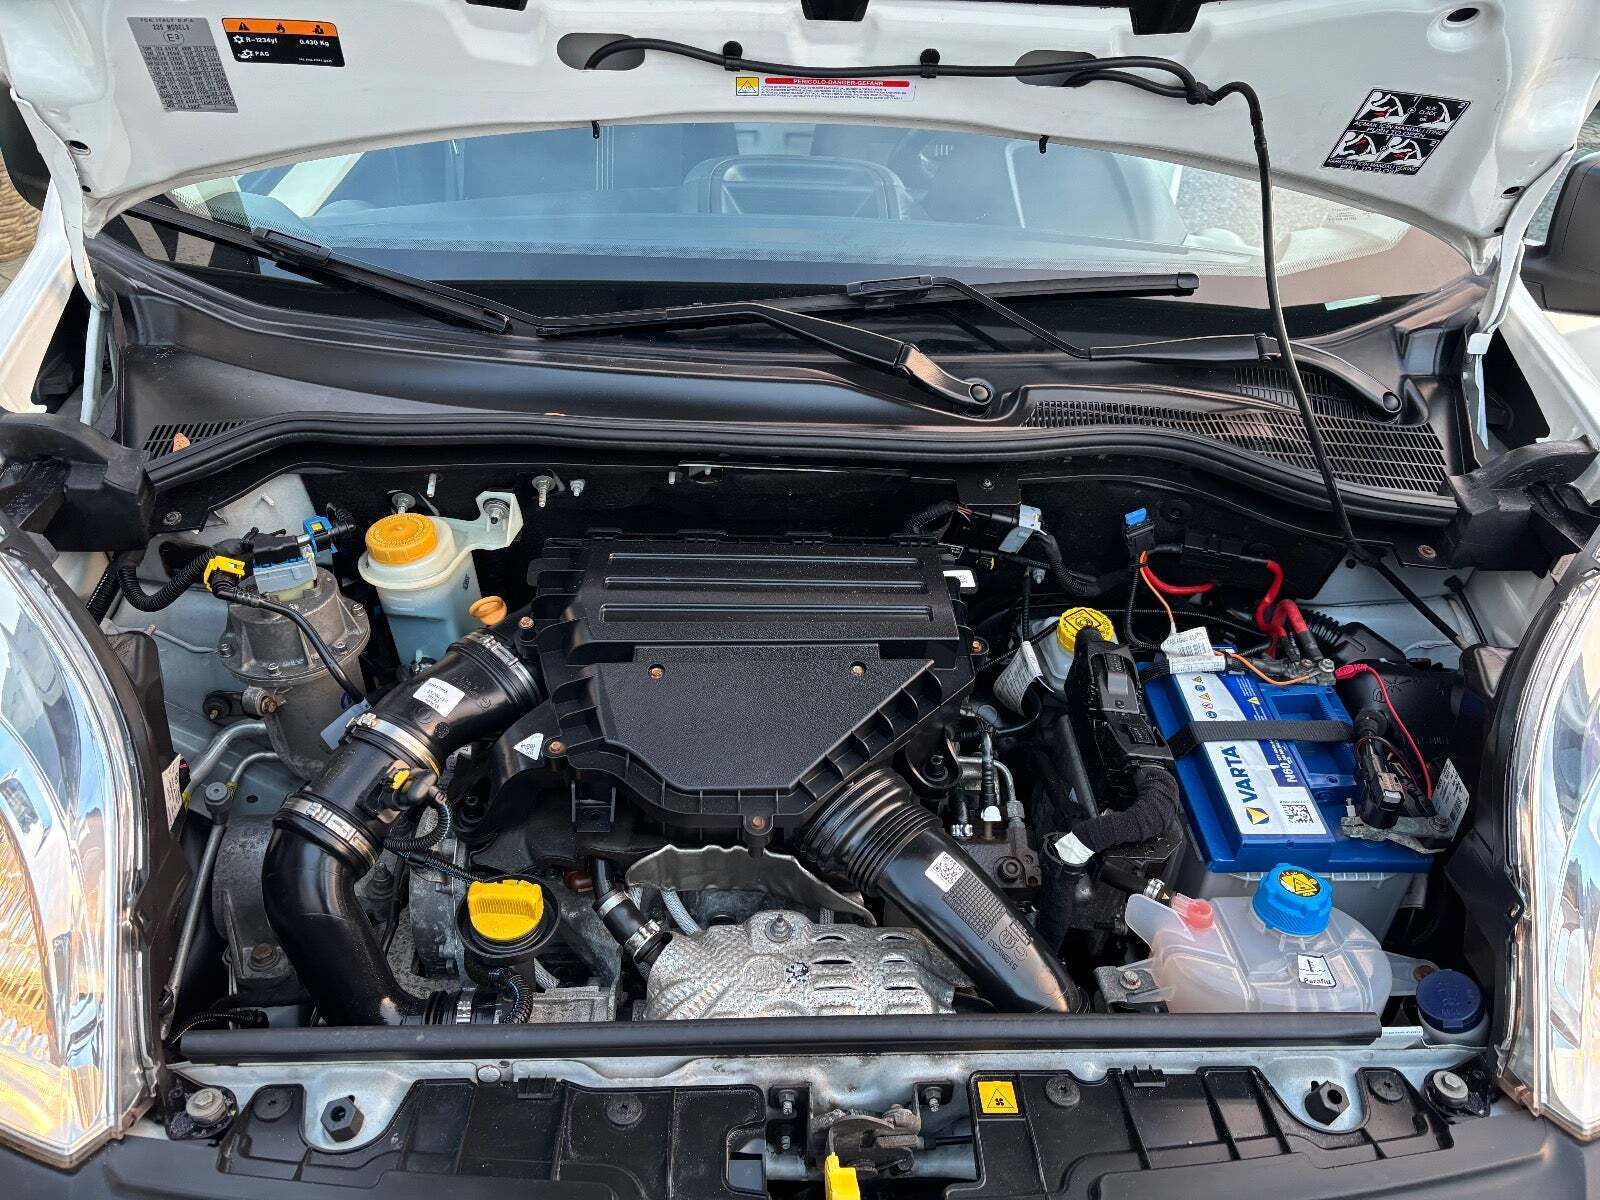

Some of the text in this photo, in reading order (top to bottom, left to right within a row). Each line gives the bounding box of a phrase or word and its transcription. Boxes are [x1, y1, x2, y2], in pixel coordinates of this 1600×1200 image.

[319, 39, 330, 48] Kg
[1221, 745, 1258, 803] VARTA
[1279, 762, 1298, 783] N60
